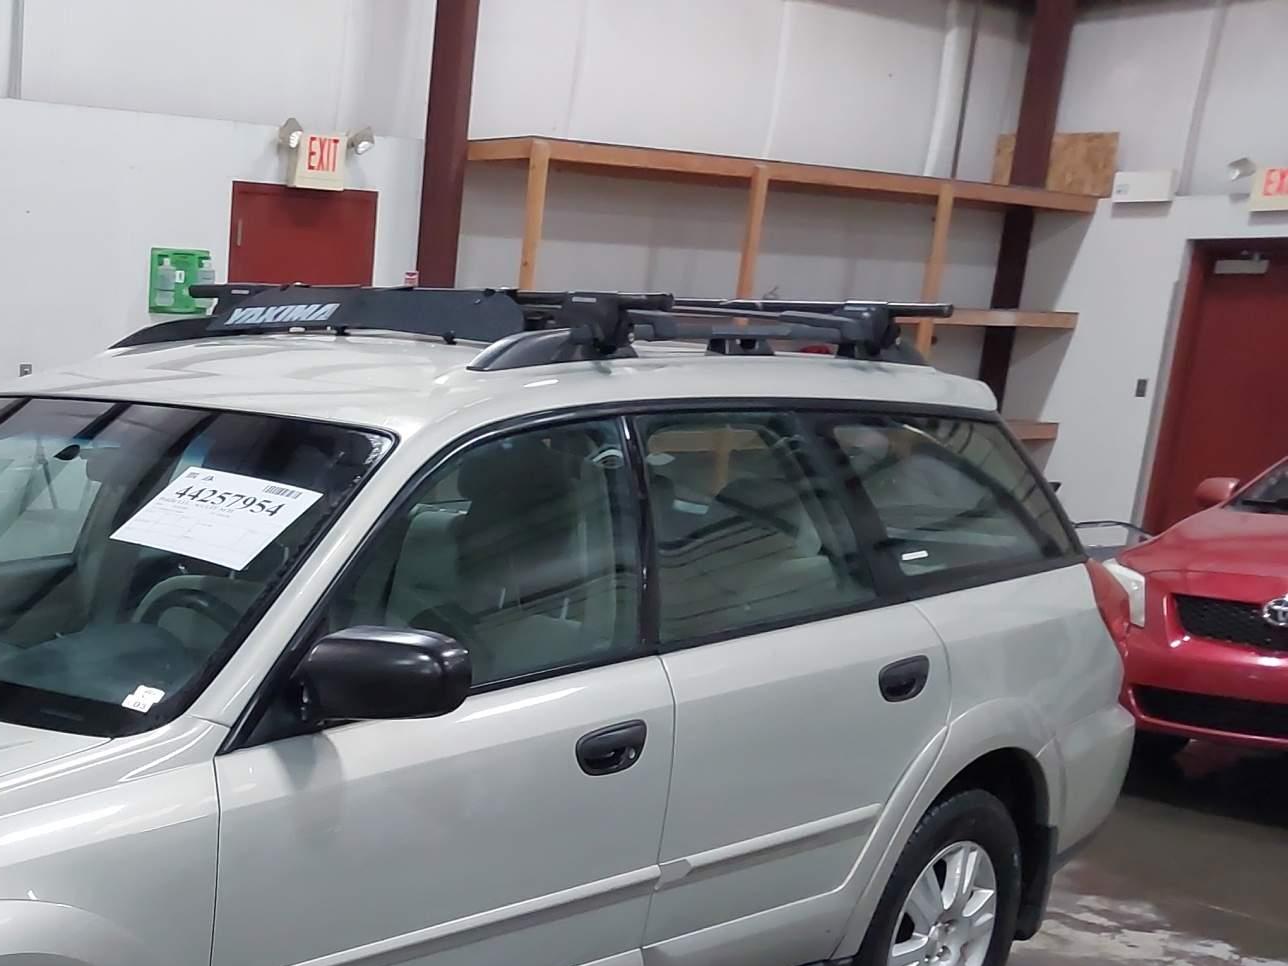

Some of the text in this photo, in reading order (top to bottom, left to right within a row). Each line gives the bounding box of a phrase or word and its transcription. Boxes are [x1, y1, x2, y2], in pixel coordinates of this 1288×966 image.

[307, 136, 340, 172] EXIT
[223, 302, 341, 326] YAKIMA
[175, 485, 285, 517] 44257954
